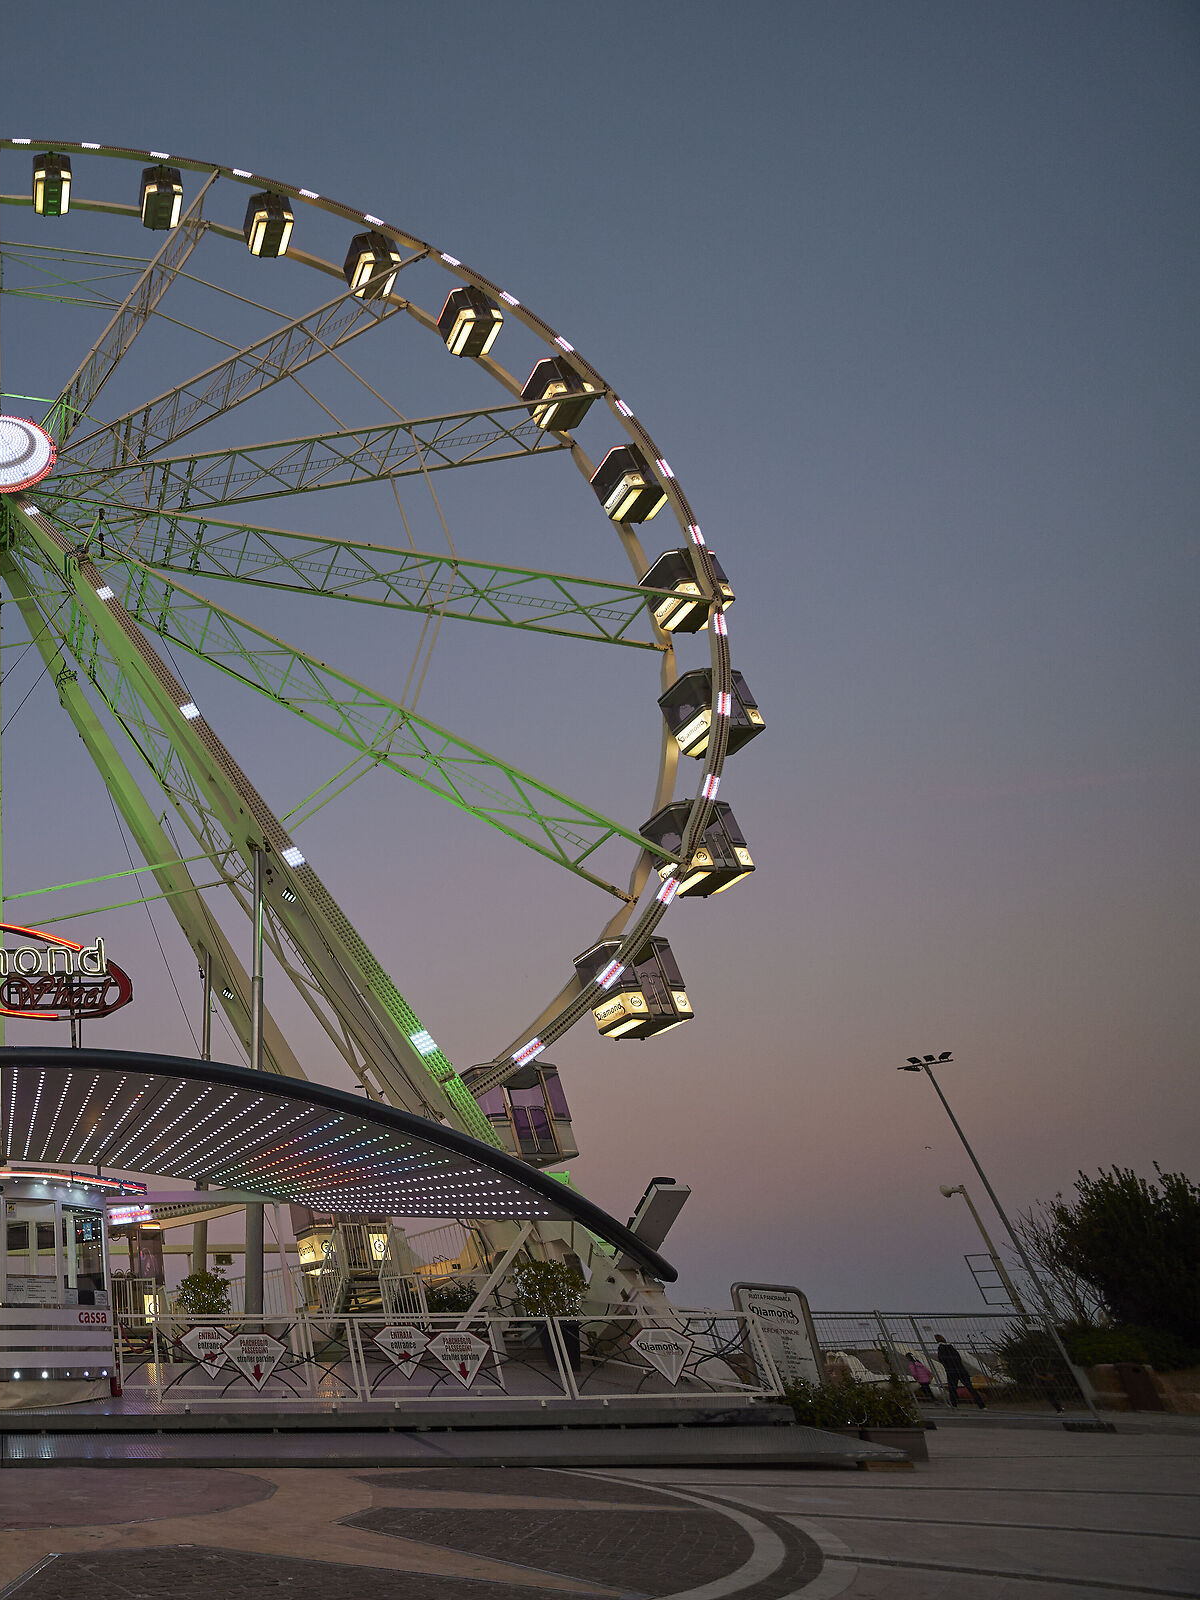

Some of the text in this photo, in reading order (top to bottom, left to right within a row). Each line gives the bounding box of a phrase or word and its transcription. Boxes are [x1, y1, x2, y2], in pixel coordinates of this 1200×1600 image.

[0, 976, 112, 1010] Wheel
[751, 1305, 795, 1318] Diamond
[78, 1312, 107, 1324] cassa
[198, 1332, 221, 1340] ENTRATA
[390, 1331, 412, 1339] ENTRATA
[240, 1339, 268, 1347] PARCHEGGIO
[390, 1341, 416, 1349] entrance
[443, 1337, 471, 1345] PARCHEGGIO
[197, 1342, 223, 1350] entrance
[639, 1342, 679, 1351] Diamond
[256, 1355, 275, 1363] parking
[441, 1353, 480, 1362] stroller parking
